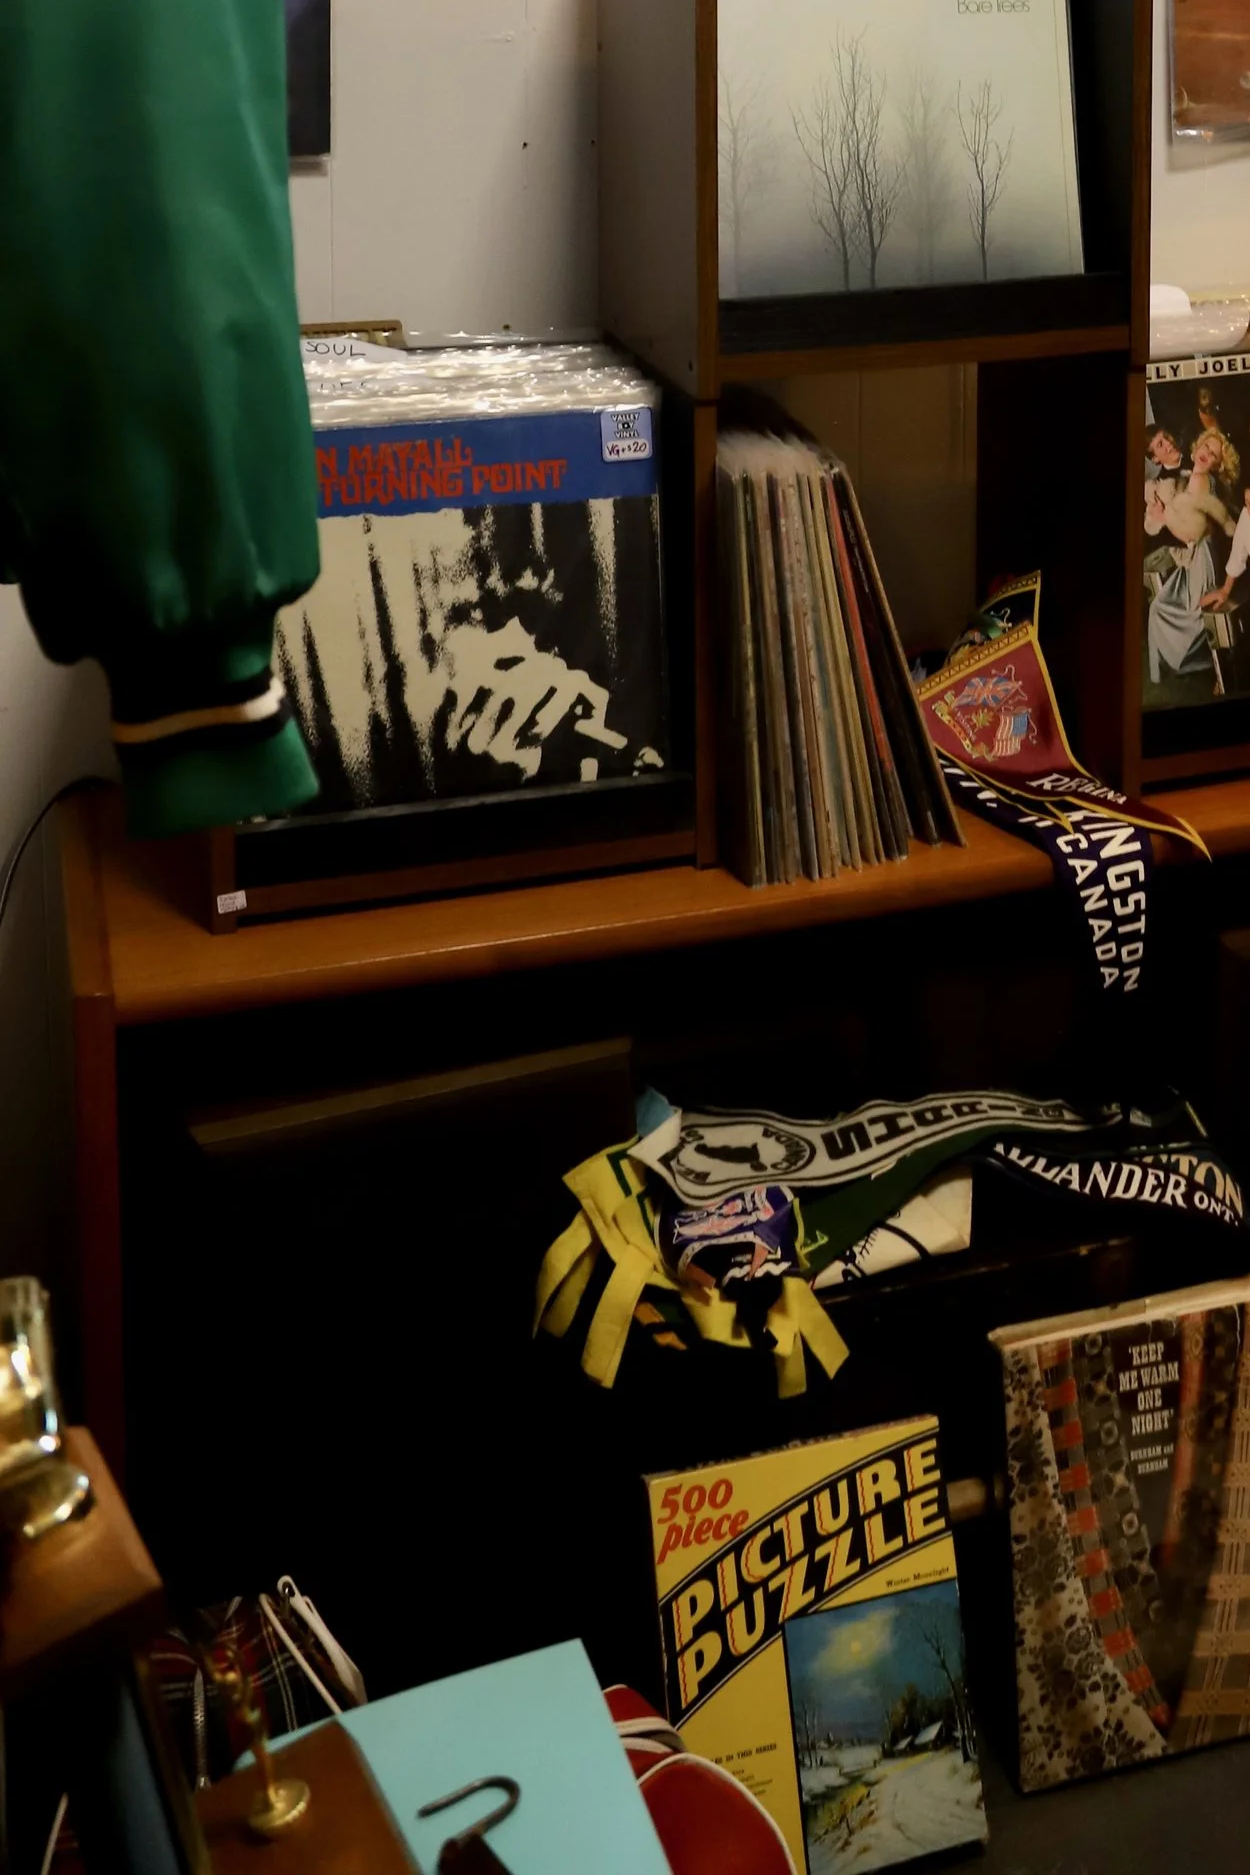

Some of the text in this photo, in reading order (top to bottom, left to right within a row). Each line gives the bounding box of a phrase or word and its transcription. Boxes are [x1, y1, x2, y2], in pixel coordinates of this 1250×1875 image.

[305, 341, 367, 357] SOUL
[611, 411, 640, 422] VALLEY
[614, 429, 640, 440] VINYL
[349, 437, 474, 473] MAYALL
[316, 458, 567, 508] TURNING POINT
[1025, 772, 1128, 806] REGINA
[1056, 832, 1120, 990] CANADA
[1064, 808, 1147, 993] KINGSTON
[1193, 1188, 1239, 1228] ONT.
[1119, 1361, 1179, 1394] ME WARM
[1137, 1387, 1163, 1412] ONE
[656, 1479, 734, 1525] 500
[656, 1510, 749, 1565] piece
[672, 1437, 942, 1654] PICTURE
[677, 1486, 947, 1711] PUZZLE
